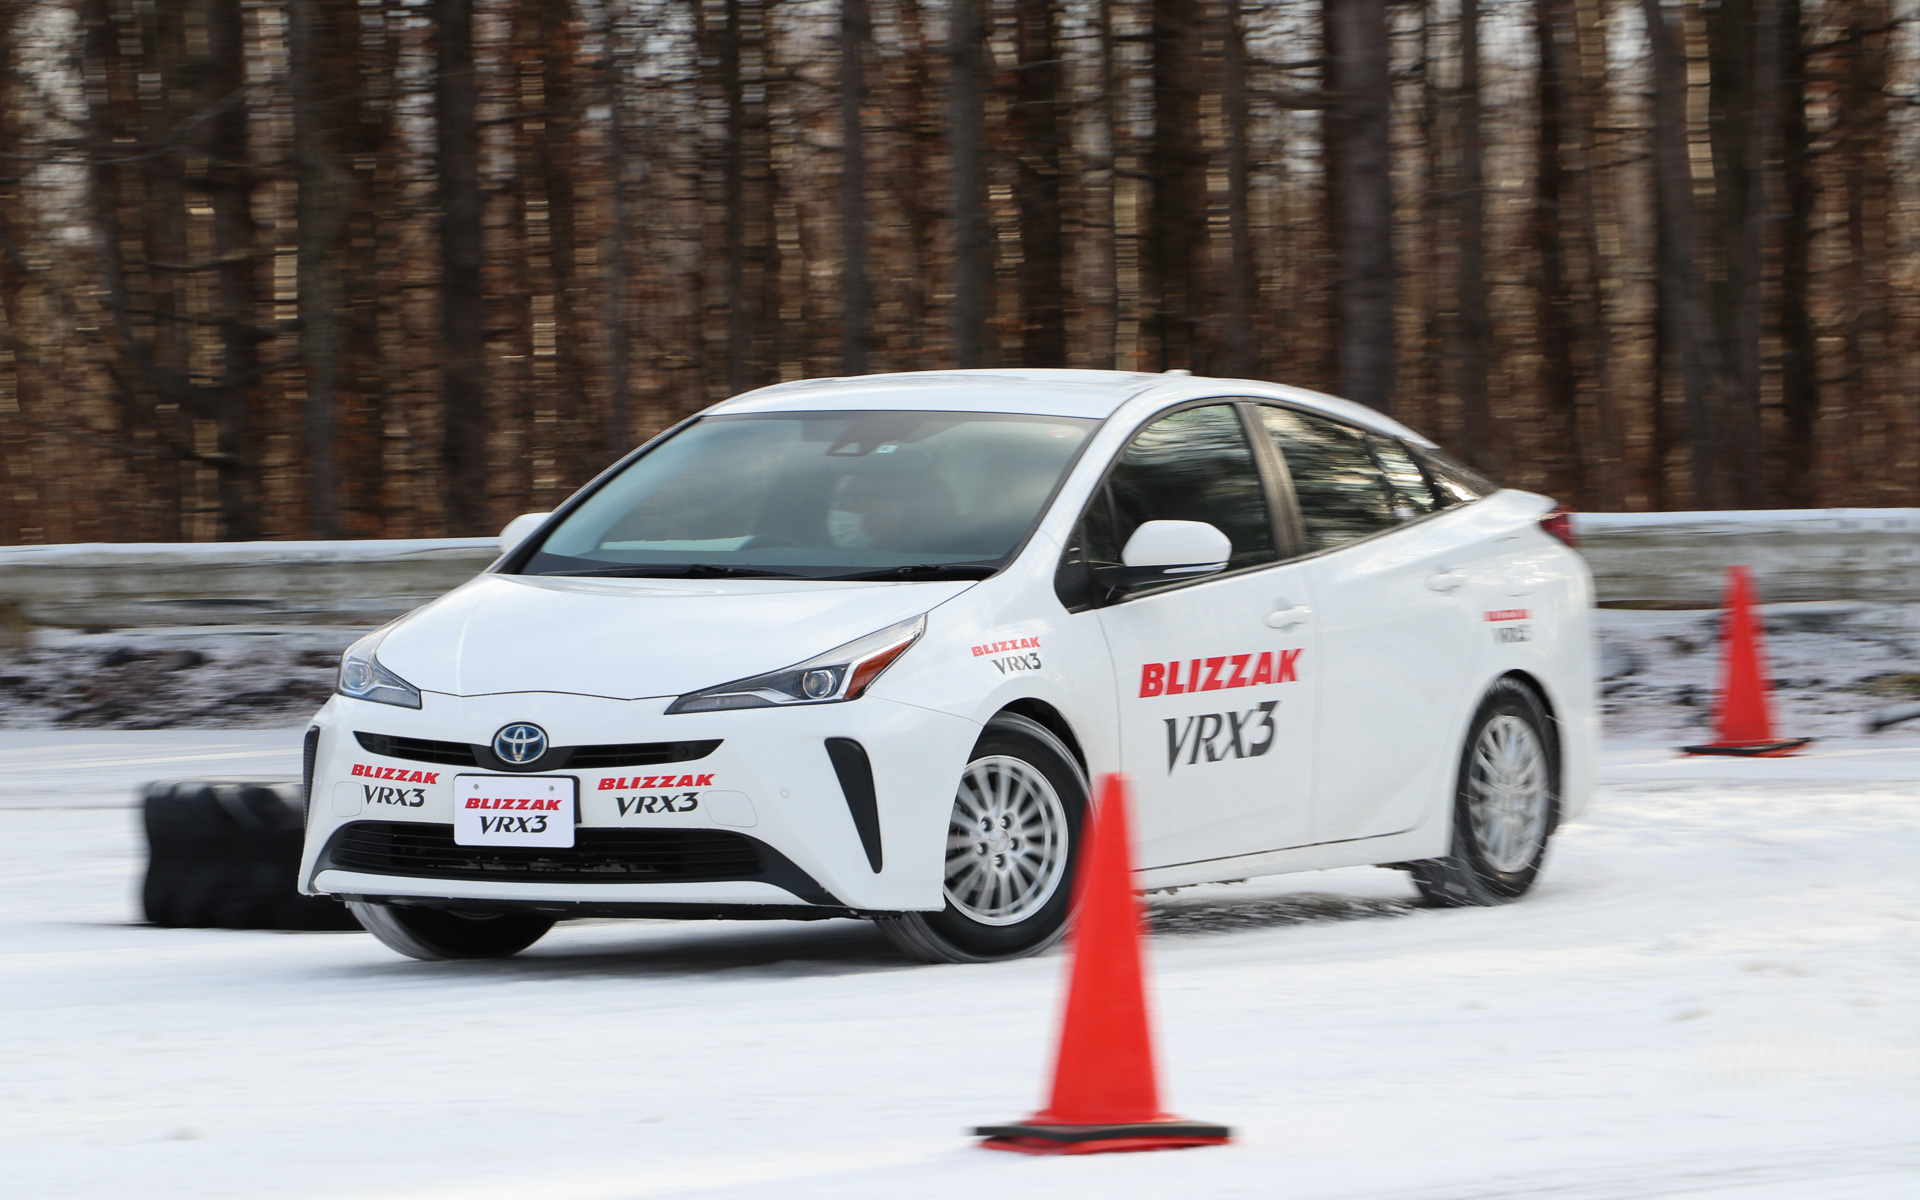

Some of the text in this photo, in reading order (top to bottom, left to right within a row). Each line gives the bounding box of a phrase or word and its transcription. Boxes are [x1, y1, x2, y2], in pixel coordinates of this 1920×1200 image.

[971, 637, 1041, 657] BLIZZAK
[990, 652, 1042, 675] VRX3
[1138, 648, 1304, 698] BLIZZAK
[1163, 700, 1280, 777] VRX3
[351, 764, 441, 785] BLIZZAK
[597, 773, 716, 791] BLIZZAK
[363, 784, 426, 808] VRX3
[465, 798, 562, 811] BLIZZAK
[615, 792, 700, 818] VRX3
[479, 815, 549, 835] VRX3
